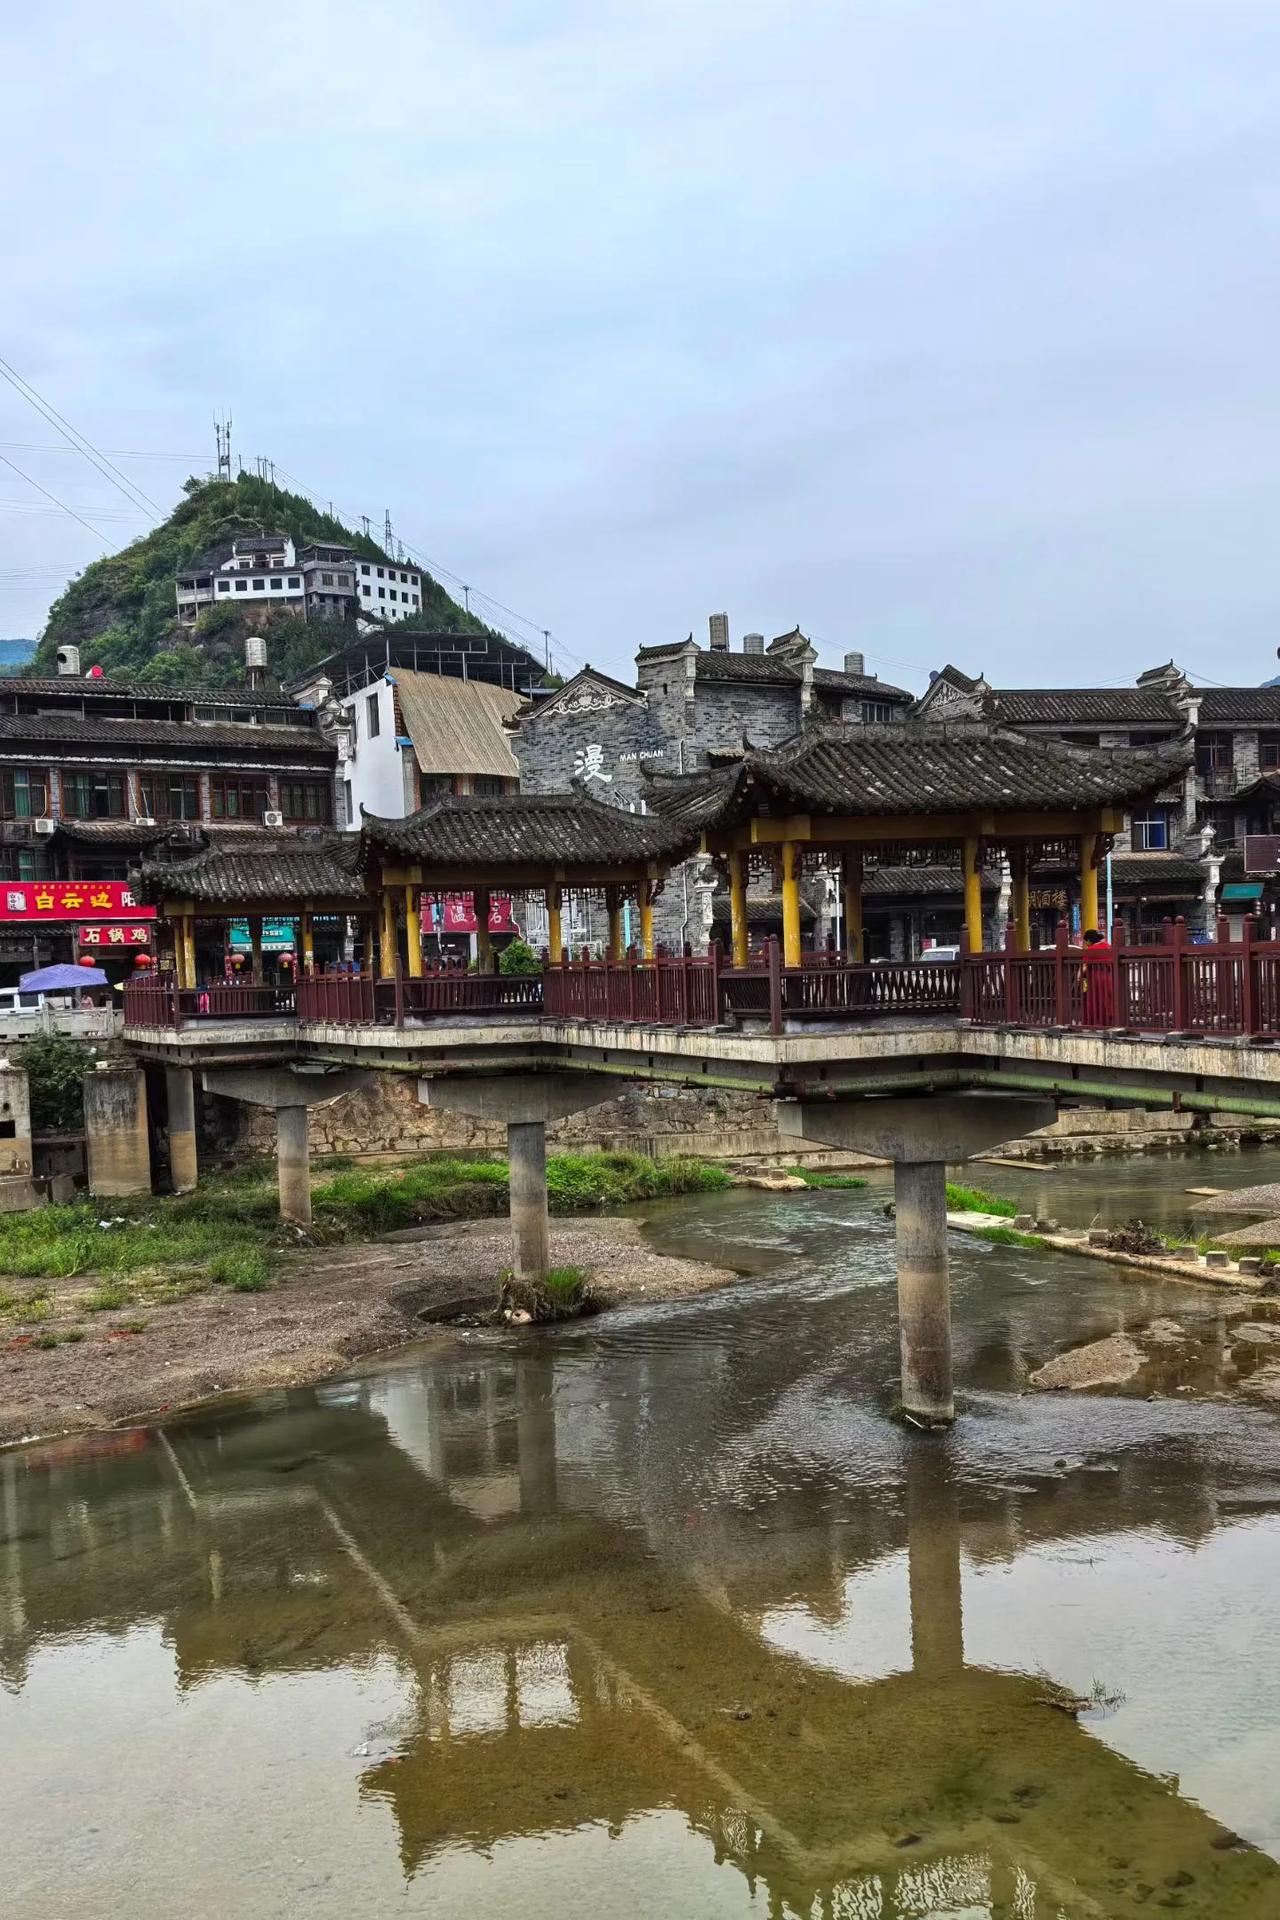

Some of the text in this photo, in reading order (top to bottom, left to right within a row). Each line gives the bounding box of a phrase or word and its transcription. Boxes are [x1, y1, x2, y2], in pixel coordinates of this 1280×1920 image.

[573, 744, 613, 783] 漫
[620, 749, 664, 762] MAN CHUAN
[34, 891, 113, 910] 白云边
[85, 927, 148, 943] 石锅鸡
